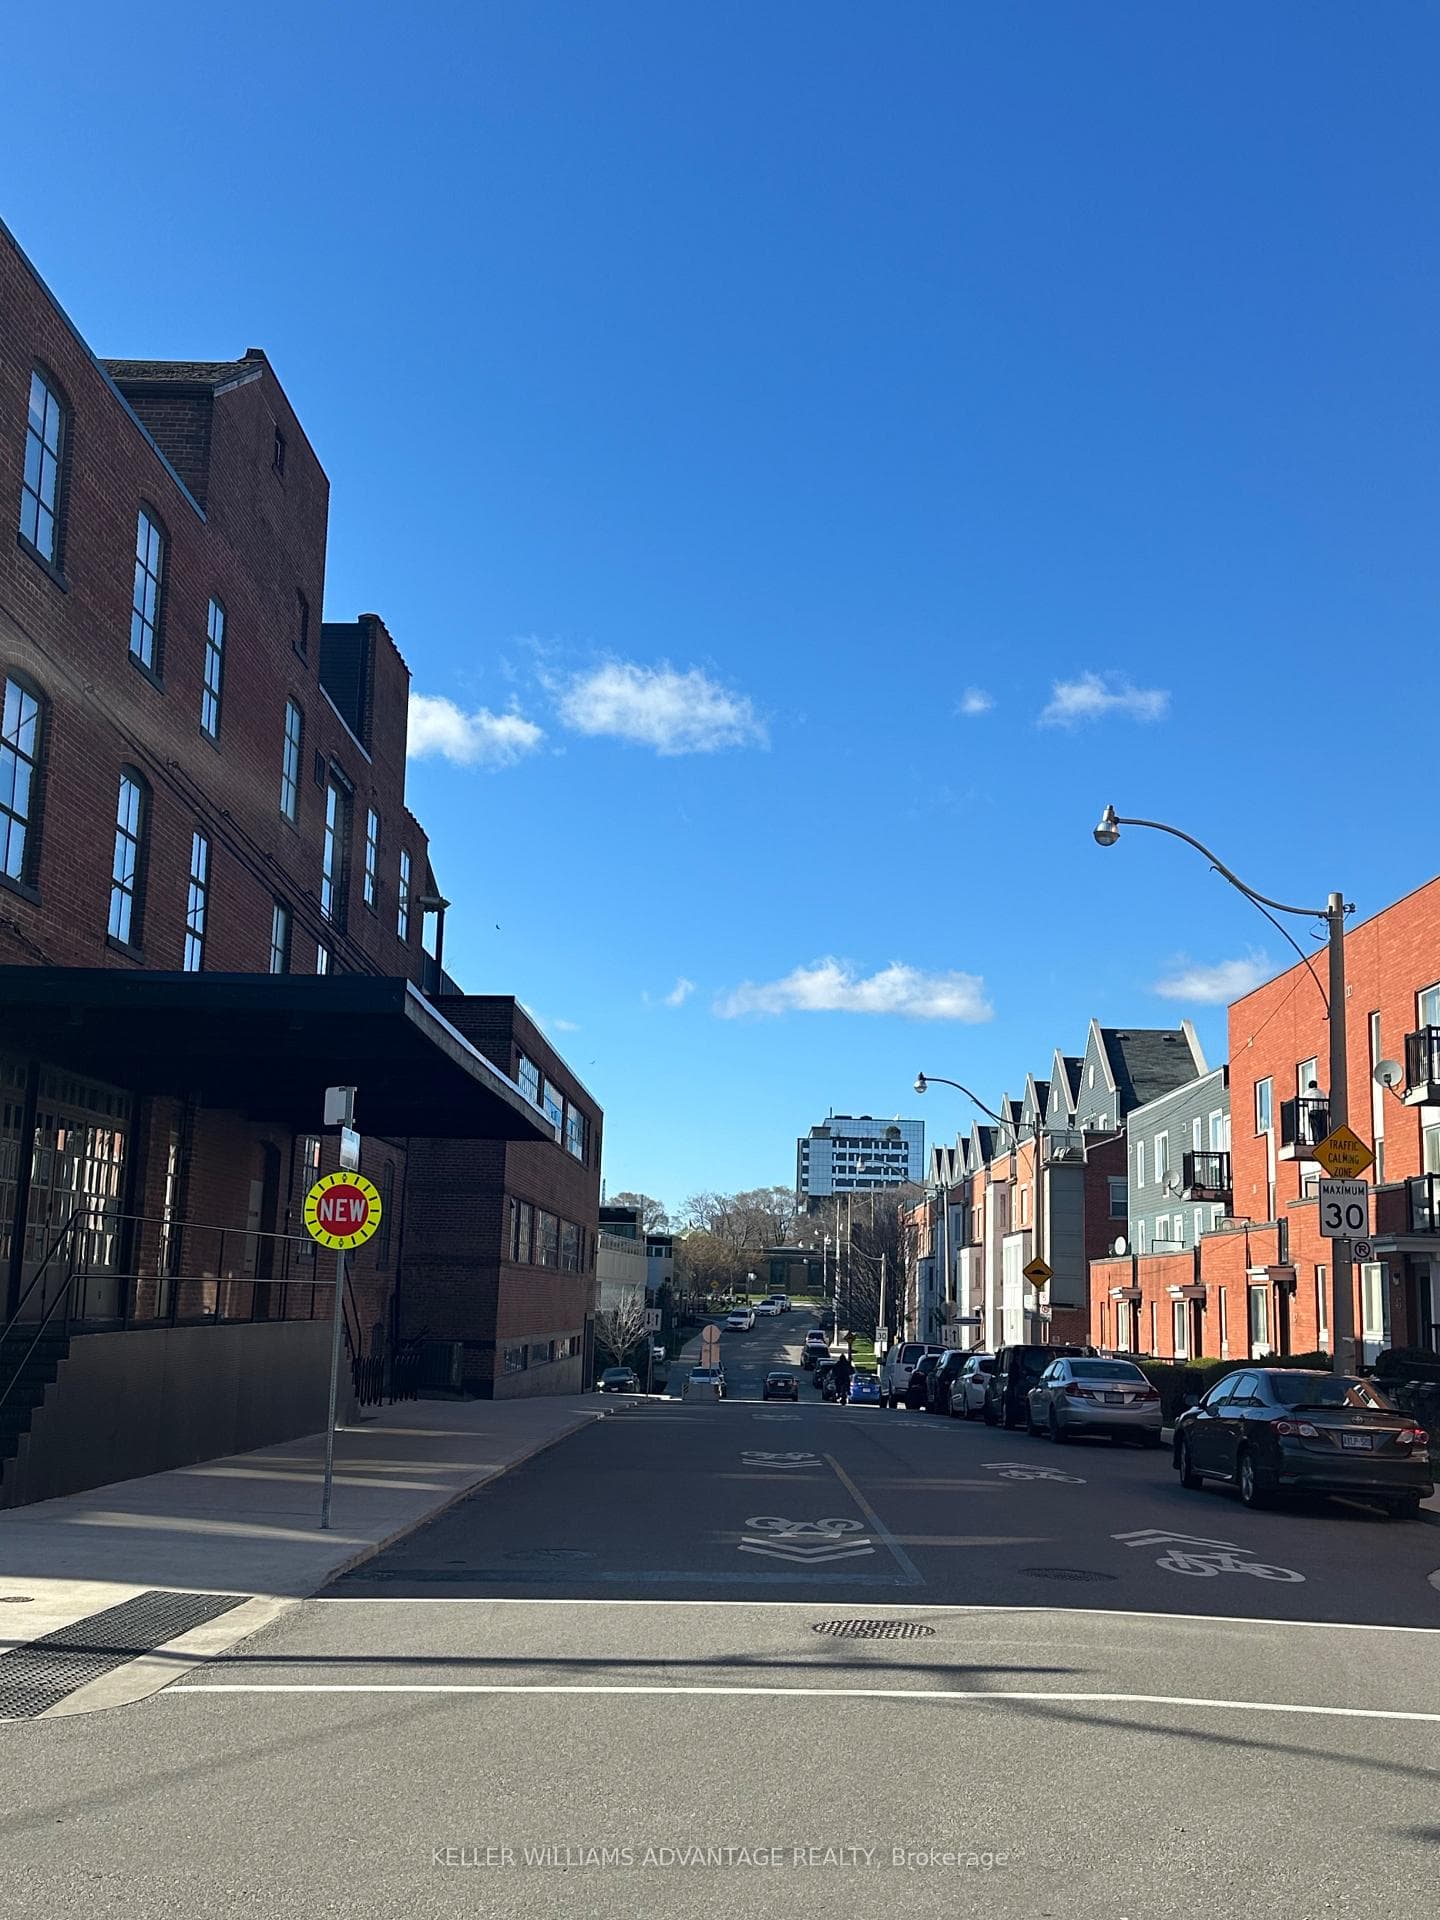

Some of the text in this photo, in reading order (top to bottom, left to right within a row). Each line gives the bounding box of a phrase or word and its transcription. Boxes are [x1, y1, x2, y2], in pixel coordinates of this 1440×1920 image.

[1330, 1140, 1359, 1151] TRAFFIC
[1328, 1152, 1360, 1164] CALMING
[1334, 1167, 1353, 1178] ZONE
[1322, 1185, 1365, 1196] MAXIMUM
[320, 1199, 365, 1222] NEW
[1325, 1203, 1364, 1229] 30
[878, 1332, 887, 1340] 30
